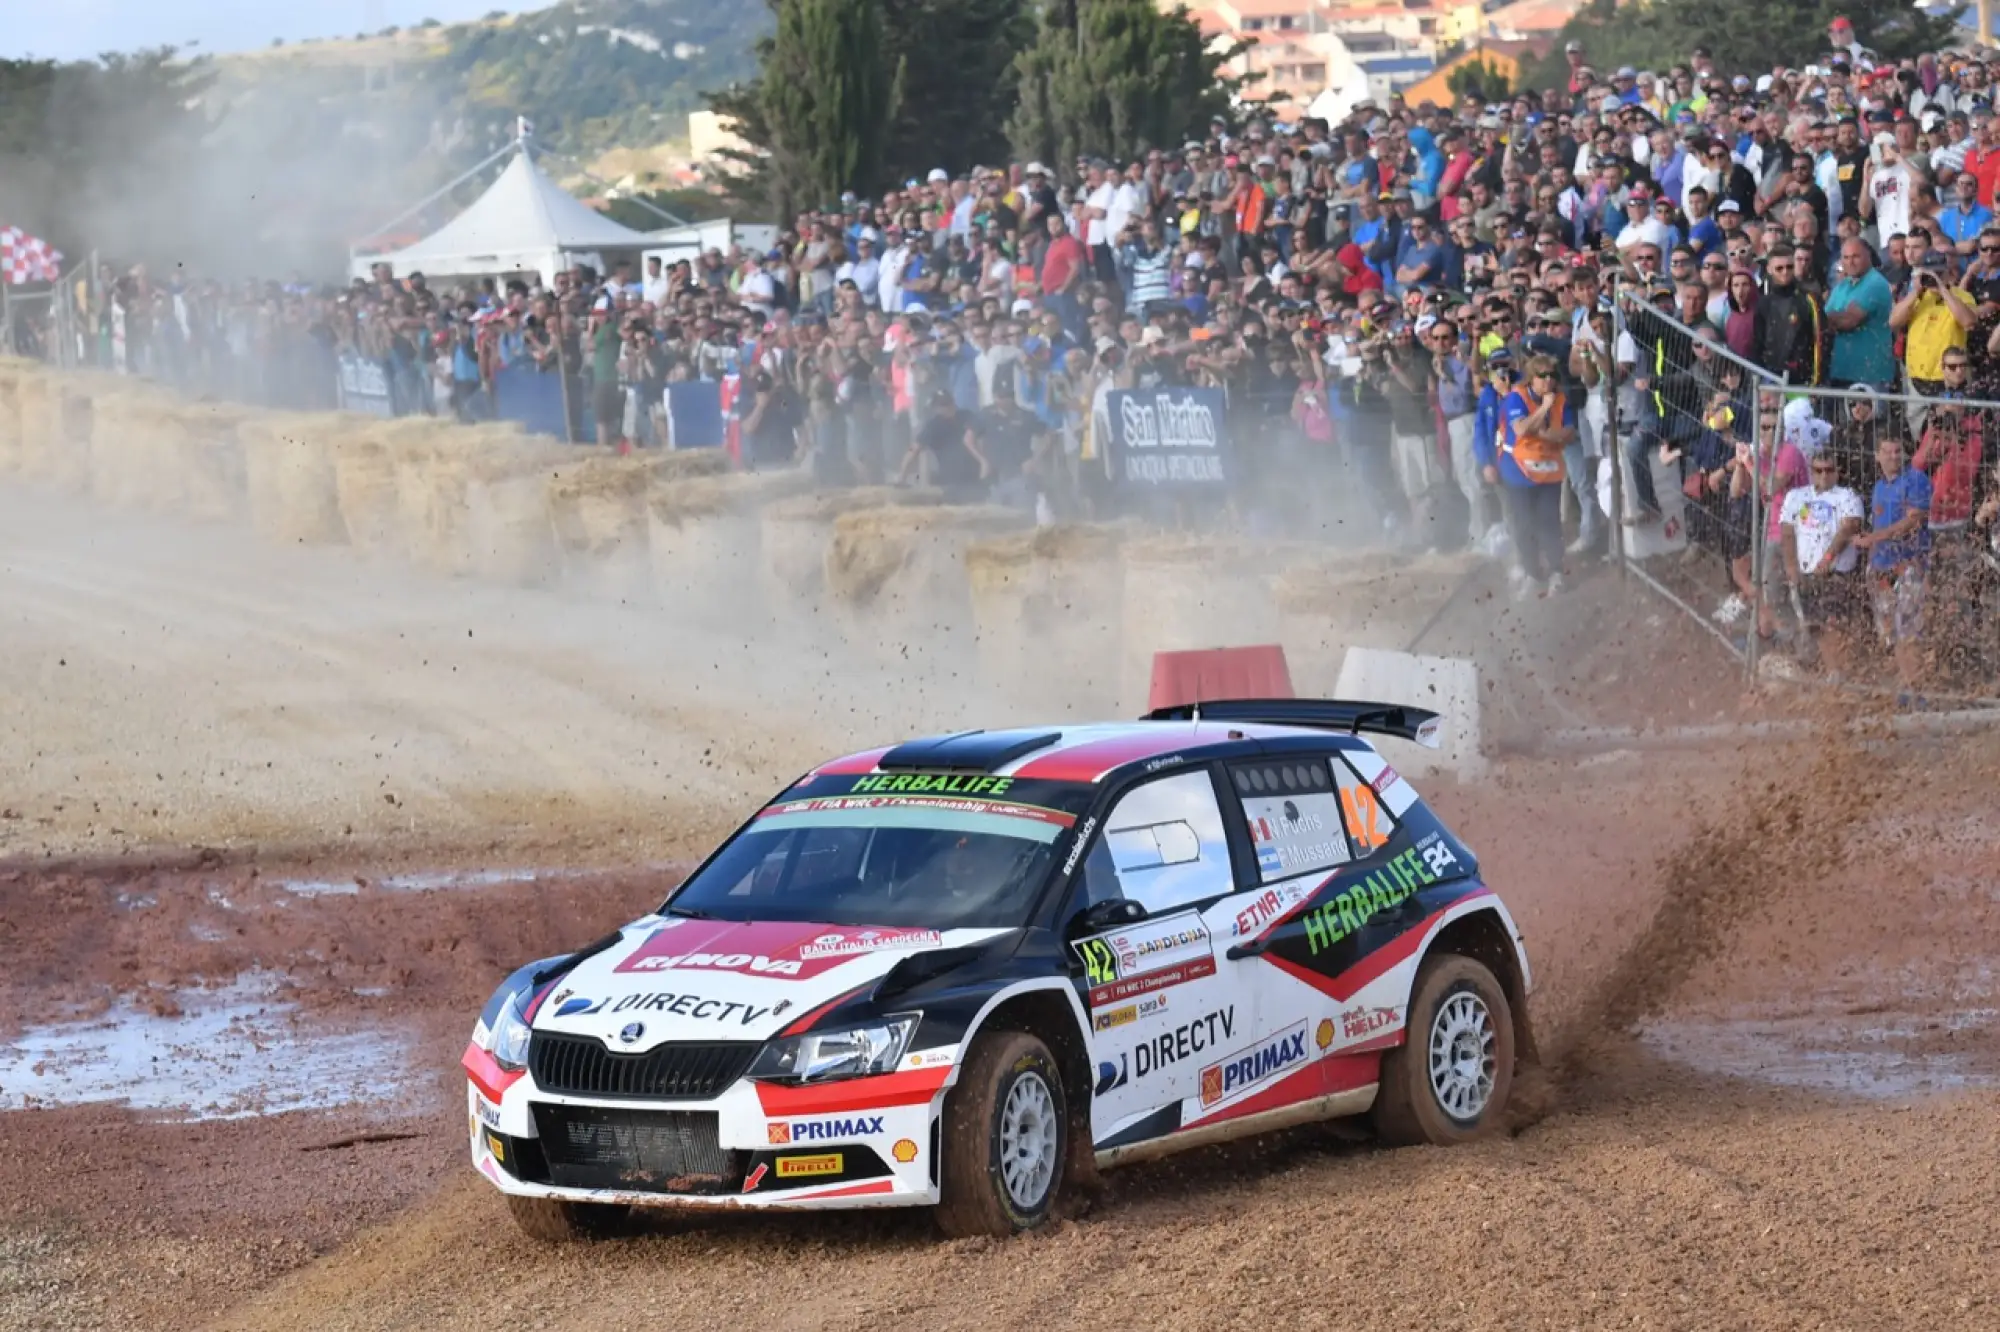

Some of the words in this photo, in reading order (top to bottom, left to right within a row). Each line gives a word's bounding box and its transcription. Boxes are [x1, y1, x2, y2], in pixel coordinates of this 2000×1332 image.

[1121, 394, 1158, 447] San
[850, 775, 1014, 795] HERBALIFE
[818, 800, 845, 810] FIA
[1339, 784, 1389, 847] 42
[1303, 847, 1436, 956] HERBALIFE
[804, 943, 838, 957] RALLY
[839, 940, 874, 952] ITALIA
[1136, 927, 1207, 956] SARDEGNA
[1082, 939, 1116, 985] 42
[611, 991, 770, 1026] DIRECTV
[1135, 1004, 1235, 1078] DIRECTV
[1224, 1028, 1307, 1093] PRIMAX
[792, 1116, 884, 1141] PRIMAX
[782, 1156, 837, 1173] PIRELLI
